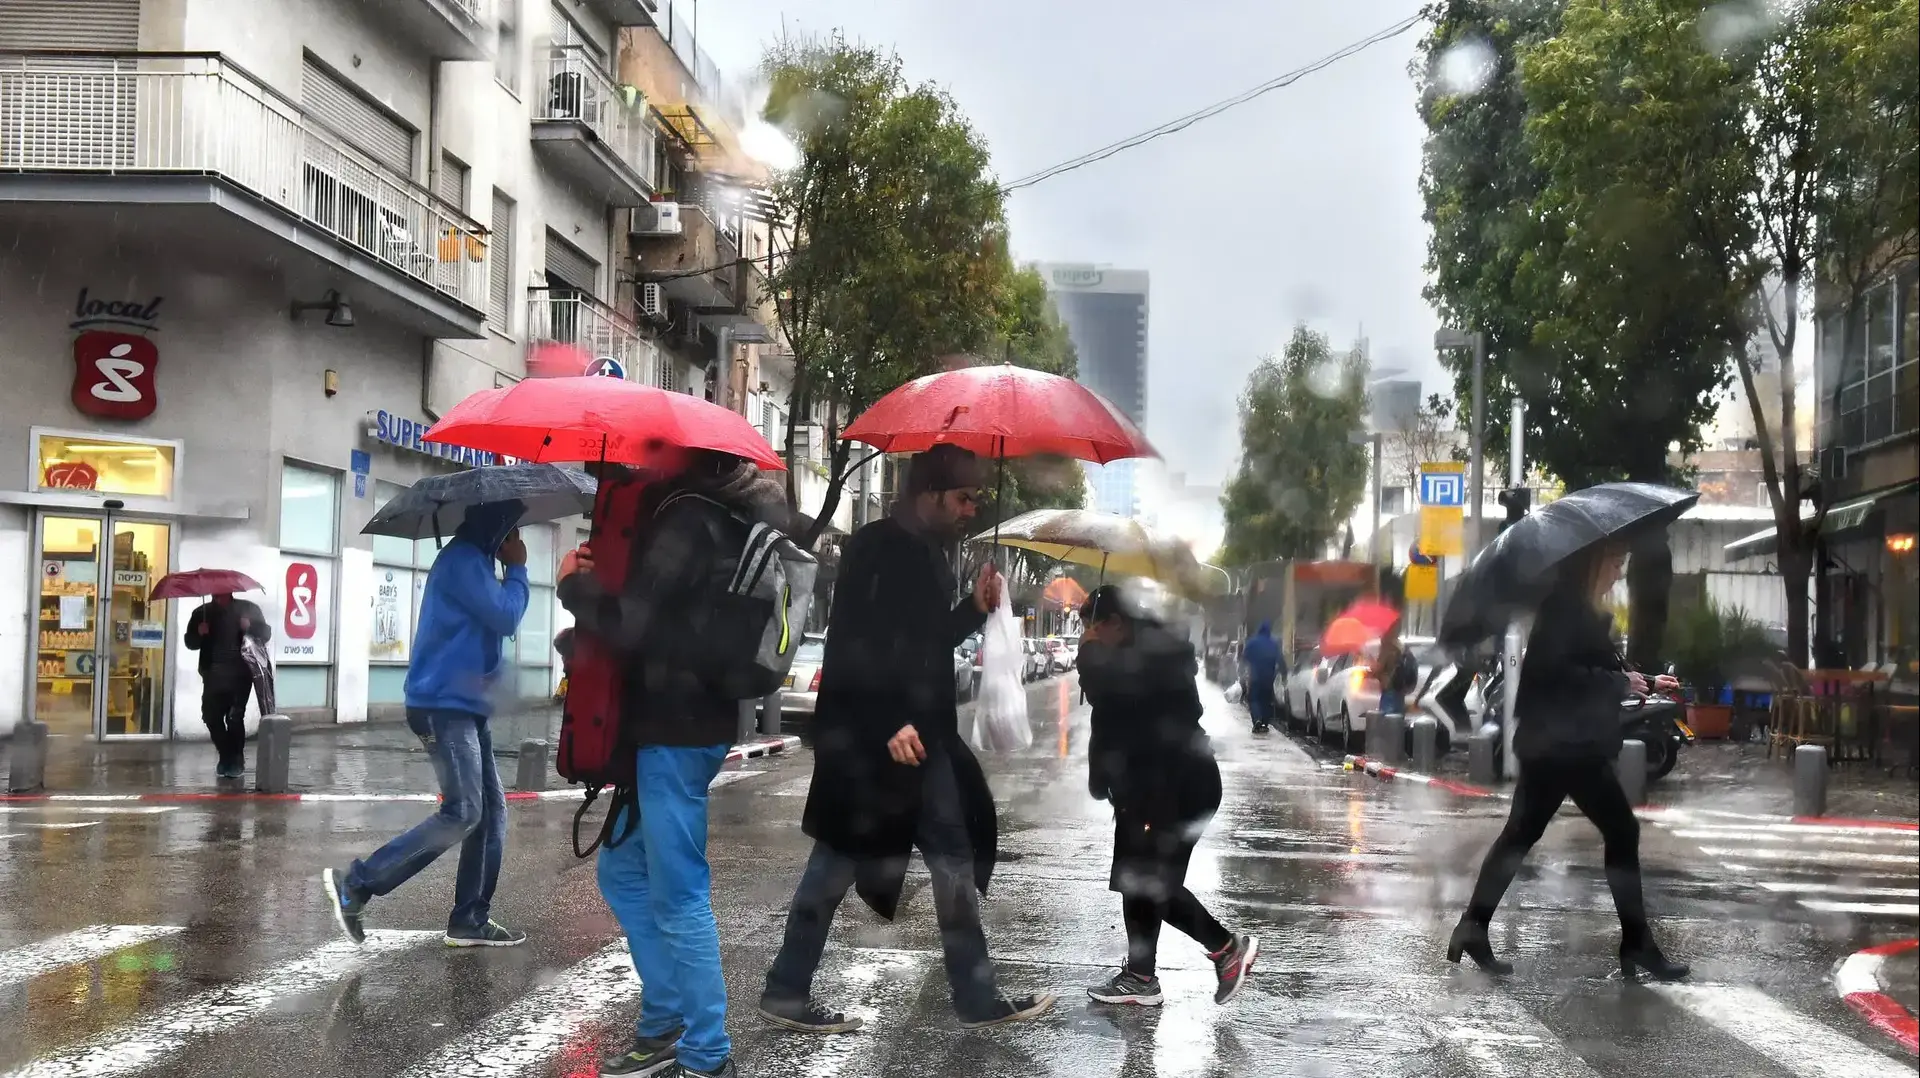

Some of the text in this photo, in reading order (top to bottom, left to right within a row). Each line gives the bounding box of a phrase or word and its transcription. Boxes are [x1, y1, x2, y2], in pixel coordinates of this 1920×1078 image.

[75, 287, 164, 320] local
[376, 409, 433, 456] SUPER
[117, 573, 143, 582] כניסה
[379, 585, 398, 597] BABY'S
